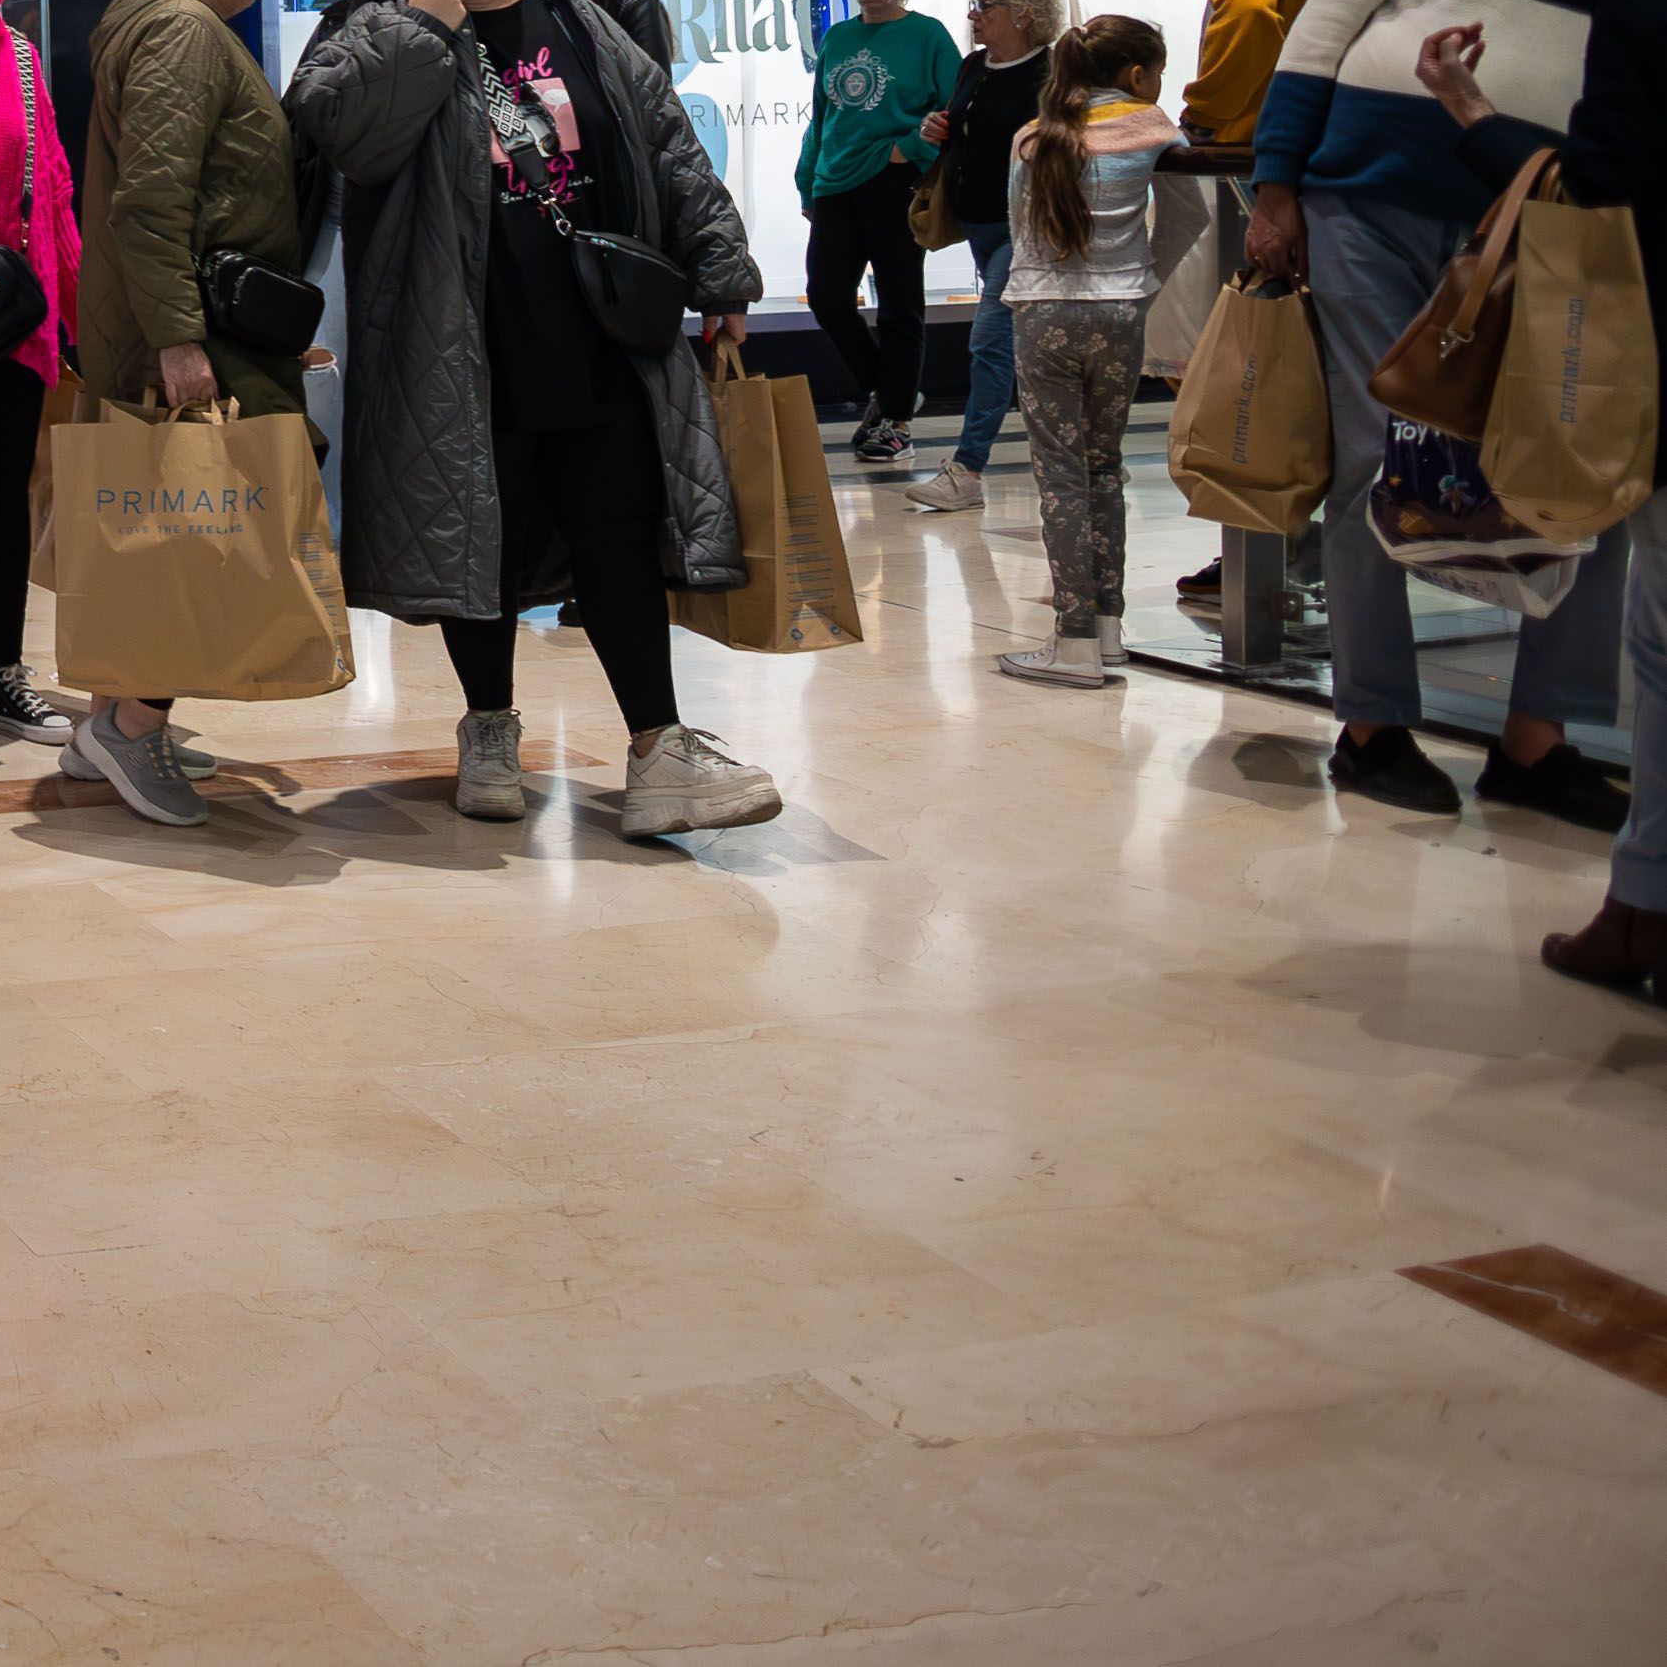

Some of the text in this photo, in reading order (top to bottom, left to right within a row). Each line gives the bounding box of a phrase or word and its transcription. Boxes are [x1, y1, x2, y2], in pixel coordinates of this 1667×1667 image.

[689, 101, 813, 128] RIMARK
[1560, 299, 1585, 424] primark.com
[1392, 419, 1429, 445] Toy
[96, 486, 266, 514] PRIMARK
[157, 524, 180, 534] THE
[188, 523, 243, 535] FEELING
